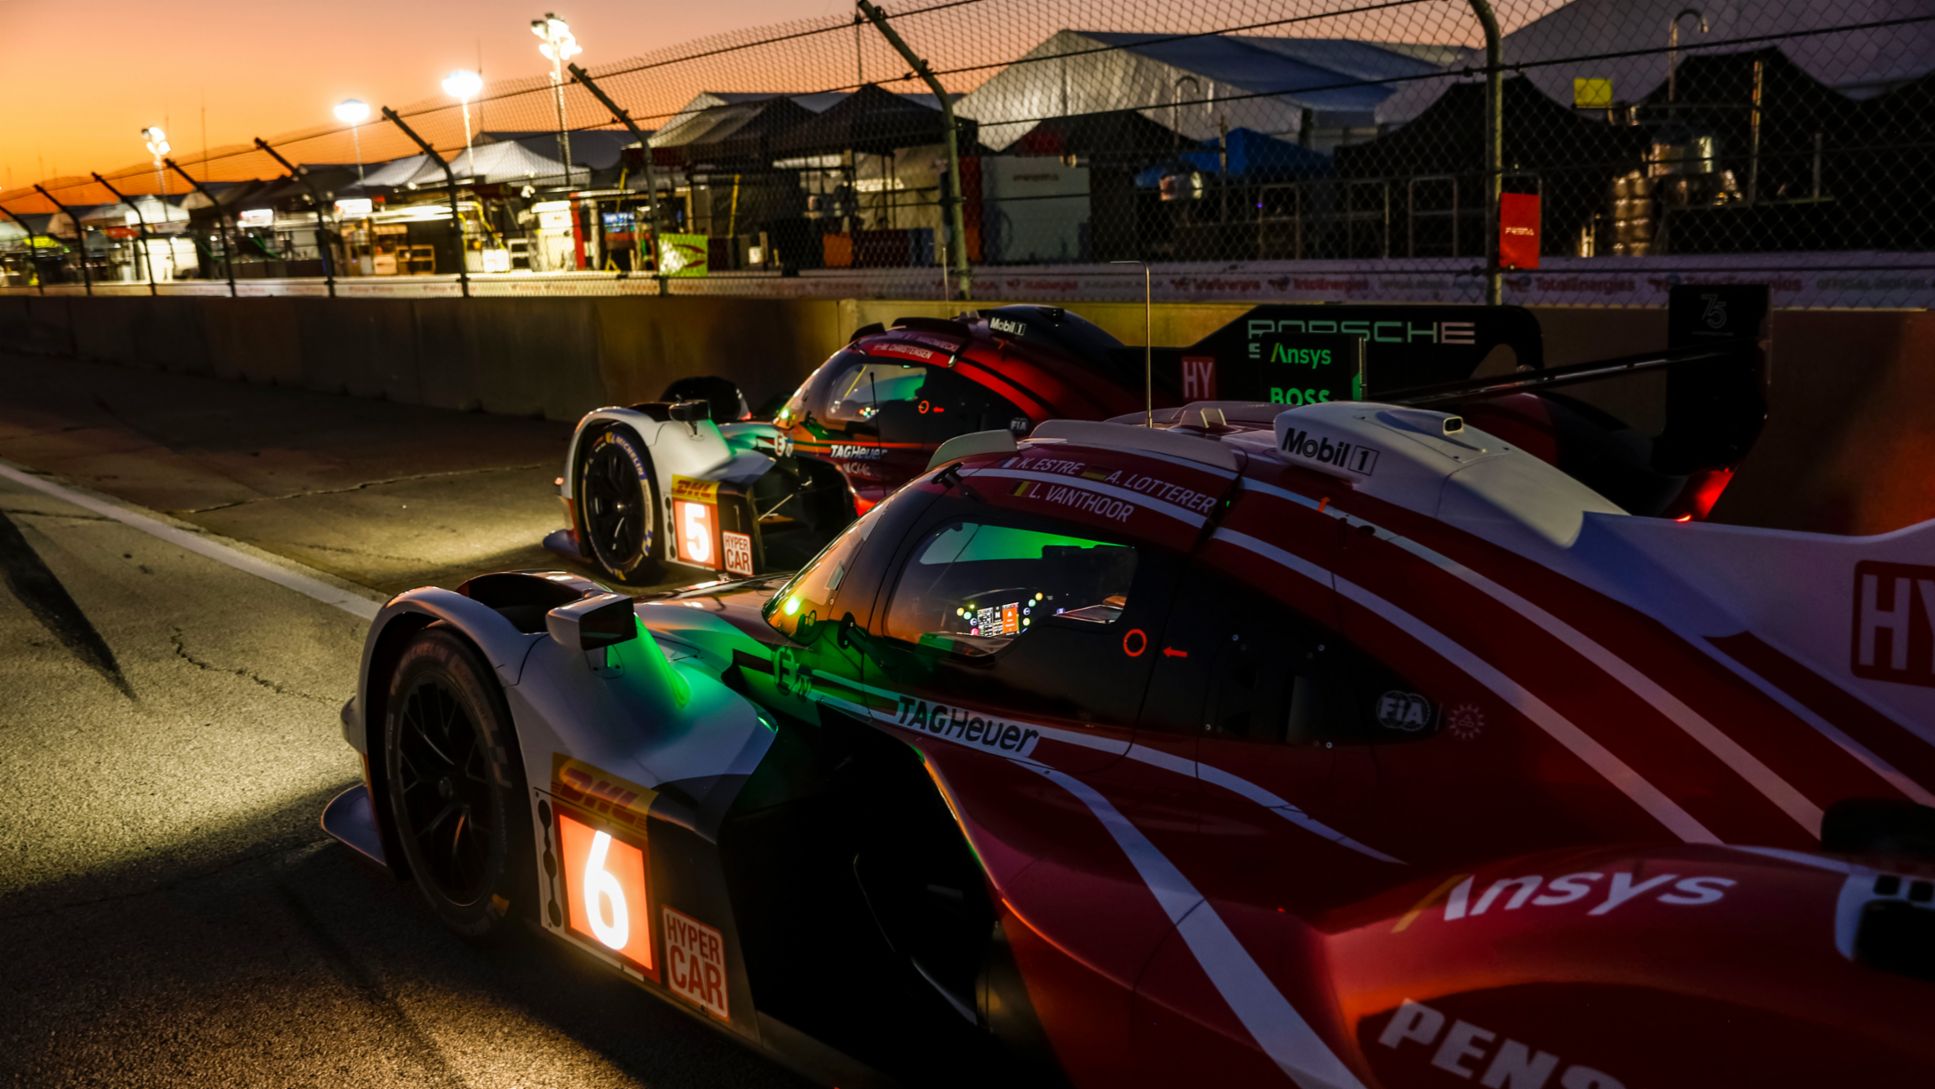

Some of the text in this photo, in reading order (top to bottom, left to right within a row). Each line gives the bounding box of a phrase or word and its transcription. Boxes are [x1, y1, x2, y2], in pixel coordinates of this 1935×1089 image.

[1537, 277, 1634, 295] TotalEnergies
[990, 317, 1016, 333] Mobil
[1248, 319, 1475, 344] PORSCHE
[1270, 342, 1332, 369] Ansys
[1183, 361, 1213, 399] HY
[1270, 387, 1331, 405] BOSS
[1011, 418, 1027, 431] FIA
[1281, 428, 1351, 467] Mobil
[1017, 457, 1217, 514] K. ESTRE A. LOTTERER
[1028, 483, 1135, 523] L. VANTHOOR
[685, 502, 709, 562] 5
[724, 535, 748, 551] HYPER
[727, 548, 751, 572] CAR
[1380, 696, 1424, 726] FIA
[583, 830, 629, 951] 6
[1391, 871, 1738, 934] Ansys
[667, 913, 720, 966] HYPER
[670, 945, 724, 1011] CAR
